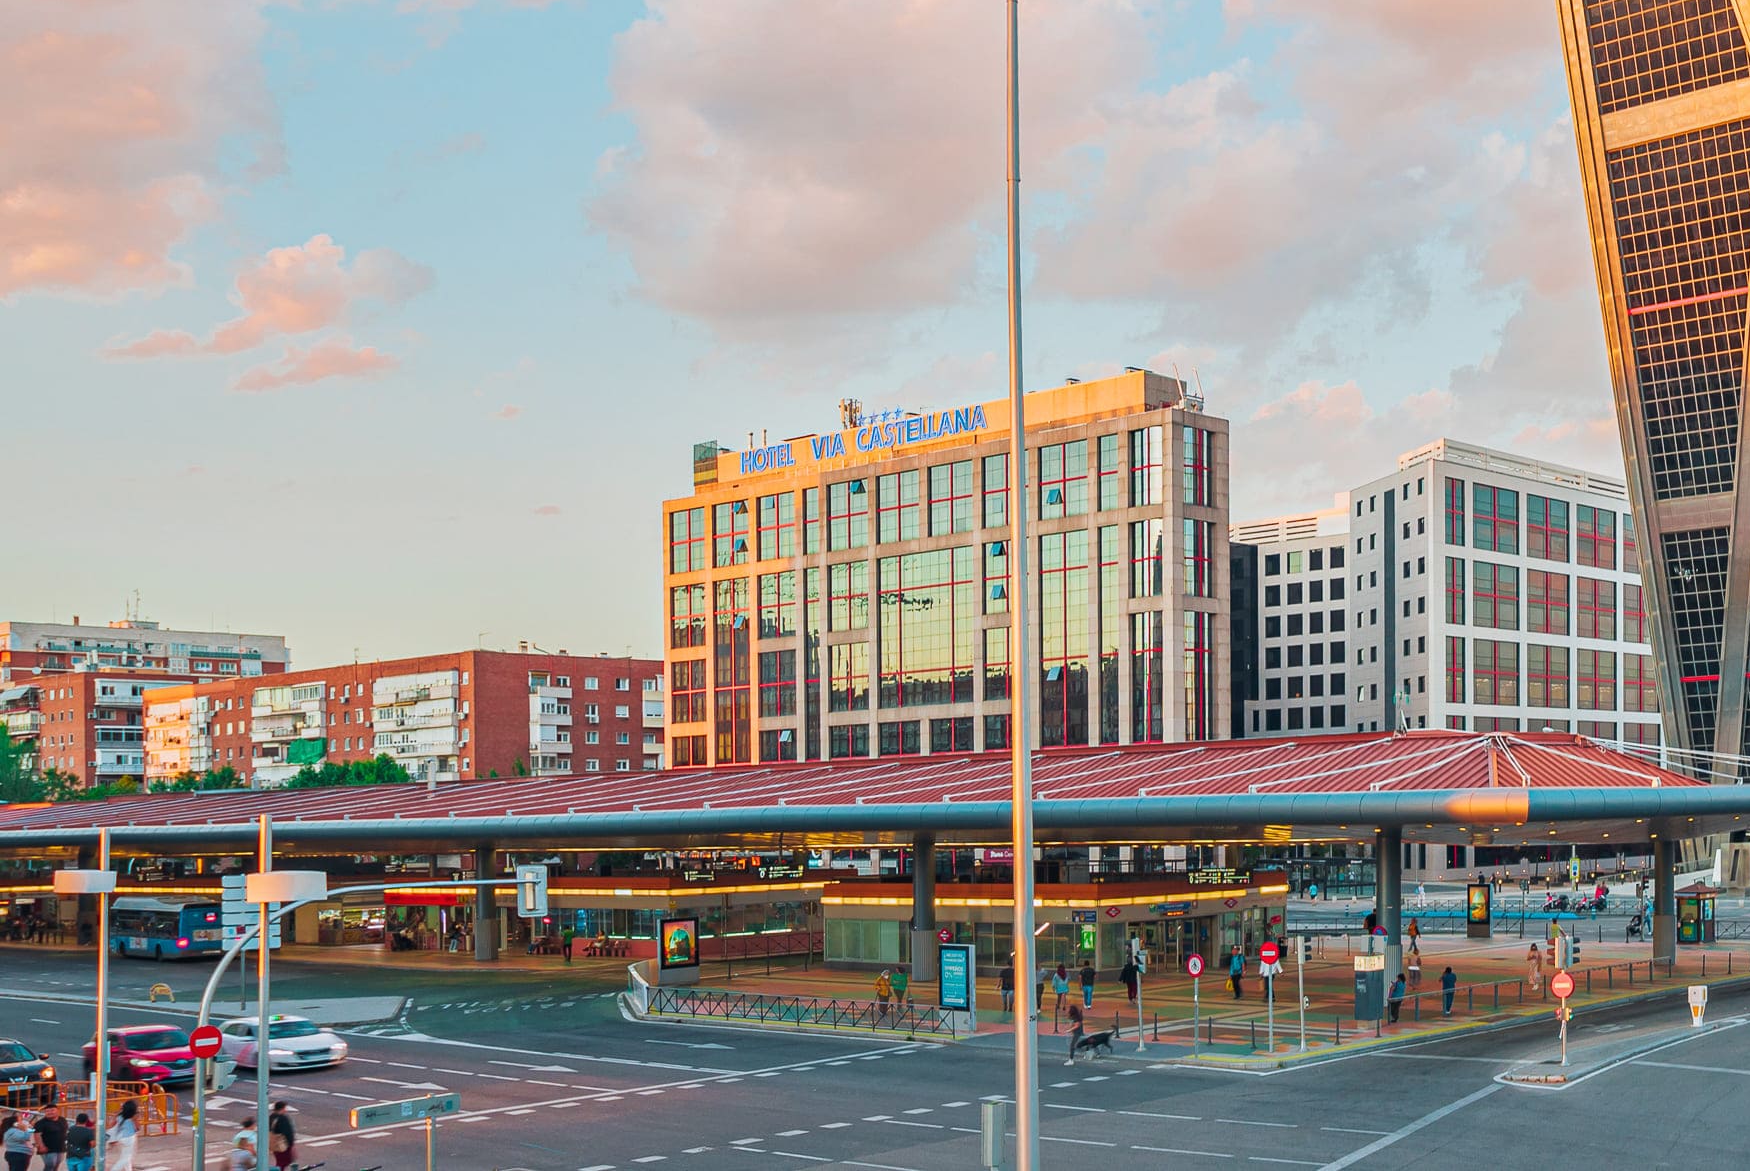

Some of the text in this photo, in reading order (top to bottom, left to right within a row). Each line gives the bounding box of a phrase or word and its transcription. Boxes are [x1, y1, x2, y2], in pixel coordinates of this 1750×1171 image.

[740, 405, 987, 474] HOTEL VIA CASTELLANA
